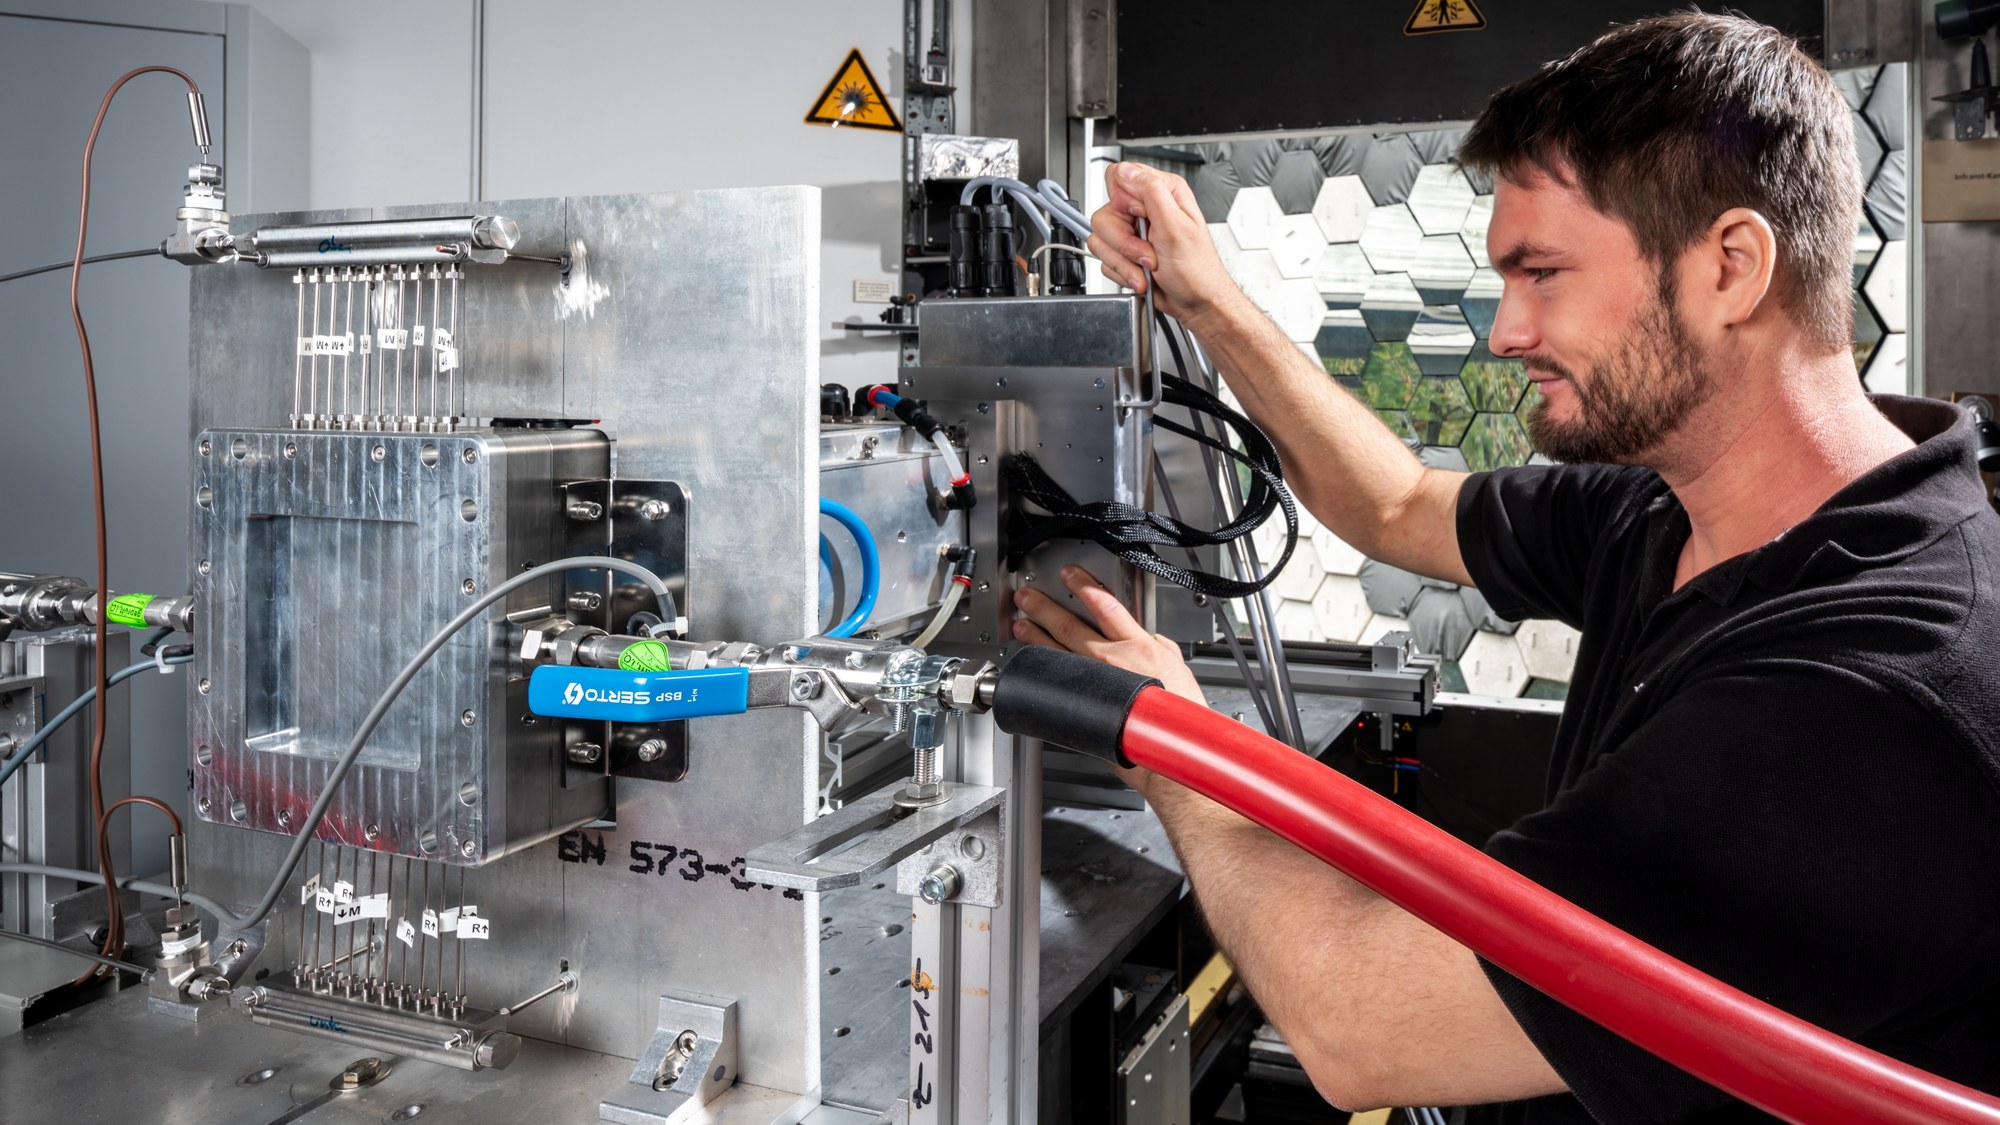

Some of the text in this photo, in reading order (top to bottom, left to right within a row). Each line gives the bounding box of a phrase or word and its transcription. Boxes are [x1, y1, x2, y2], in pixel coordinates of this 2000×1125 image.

[585, 688, 651, 705] SERTO
[655, 691, 682, 702] BSP
[557, 830, 607, 866] EN
[342, 888, 349, 898] R
[318, 896, 326, 907] R
[349, 905, 361, 917] M
[424, 919, 431, 929] R
[472, 923, 481, 933] R
